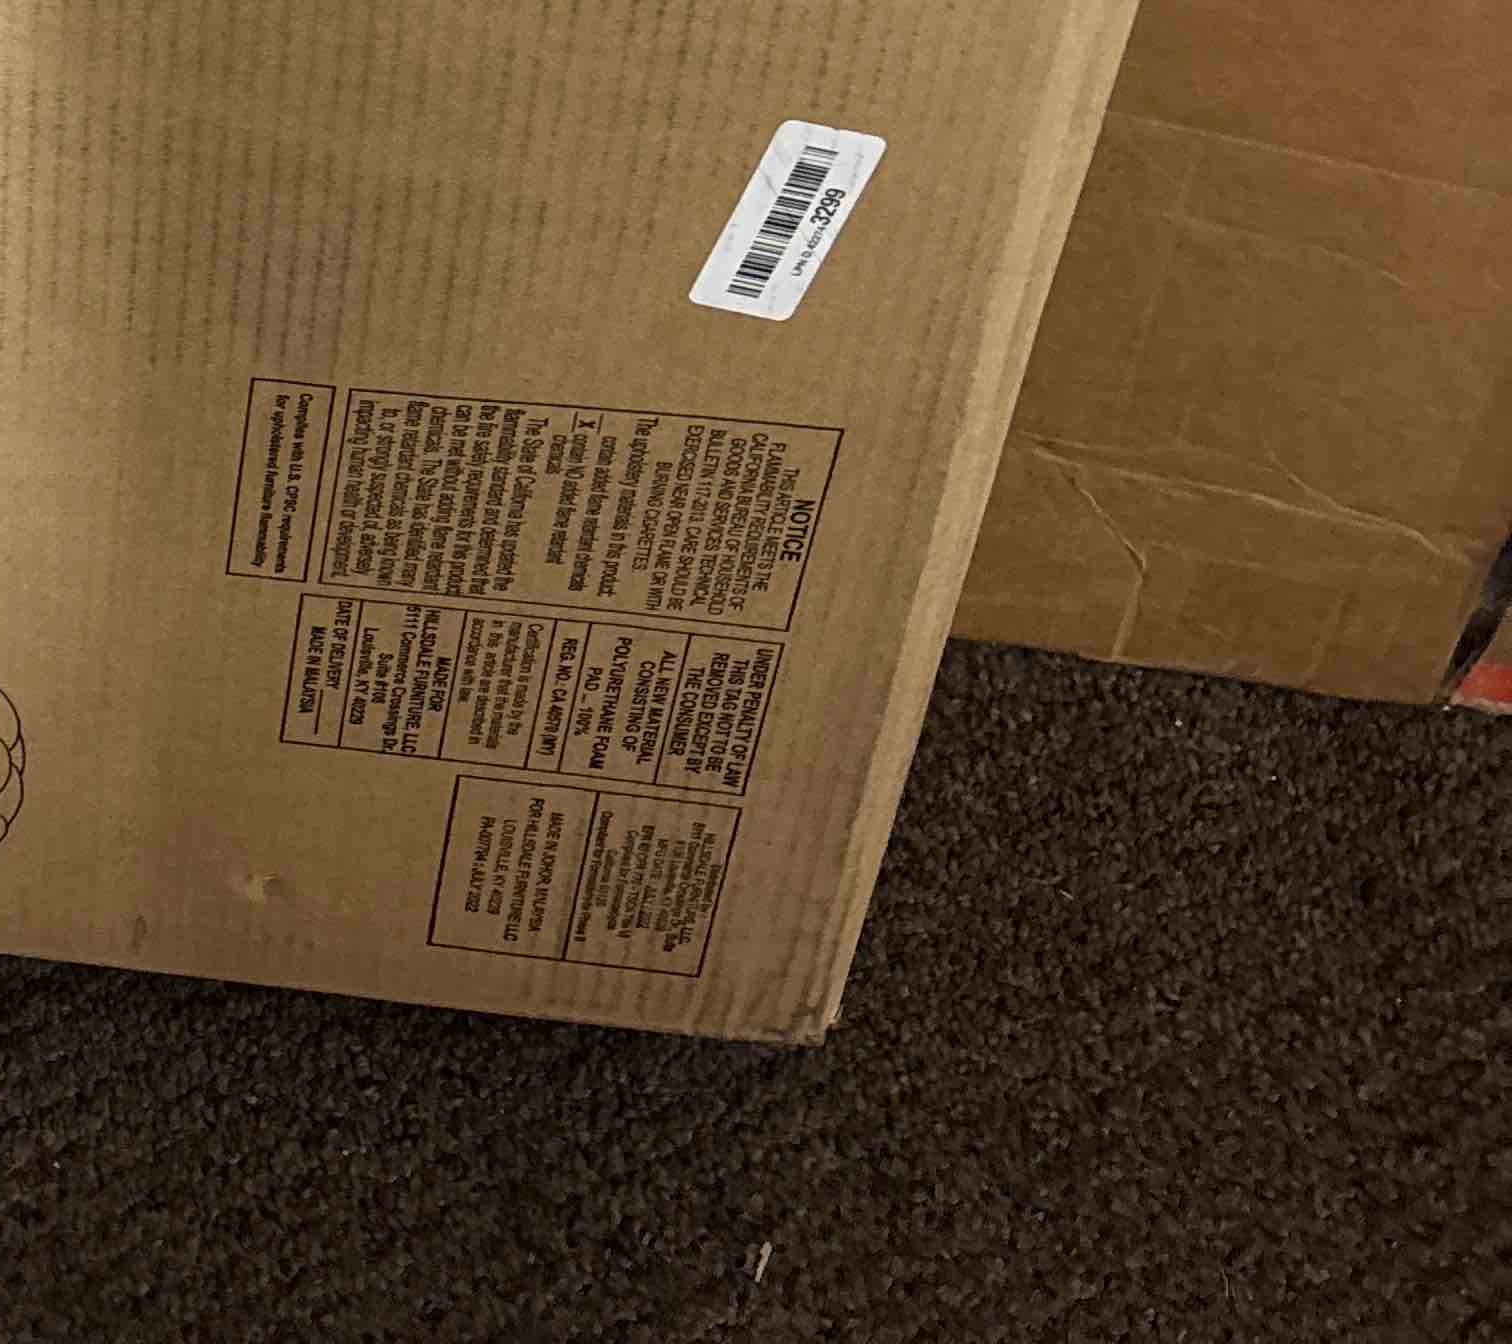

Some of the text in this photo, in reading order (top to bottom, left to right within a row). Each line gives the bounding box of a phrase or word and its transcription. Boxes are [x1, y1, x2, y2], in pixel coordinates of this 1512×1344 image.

[779, 499, 816, 562] NOTICE
[415, 608, 441, 668] HILLSDALE
[583, 666, 603, 692] PAD
[427, 656, 452, 712] MADE FOR
[550, 687, 567, 703] CA
[586, 636, 633, 769] POLYURETHANE FOAM
[619, 661, 656, 752] CONSISTING OF
[634, 650, 678, 765] ALL NEW MATERIAL
[666, 666, 706, 756] THE CONSUMER
[683, 652, 731, 773] REMOVED EXCEPT BY
[704, 658, 750, 772] THIS TAG NOT TO BE
[720, 648, 775, 787] UNDER PENALTY OF LAW
